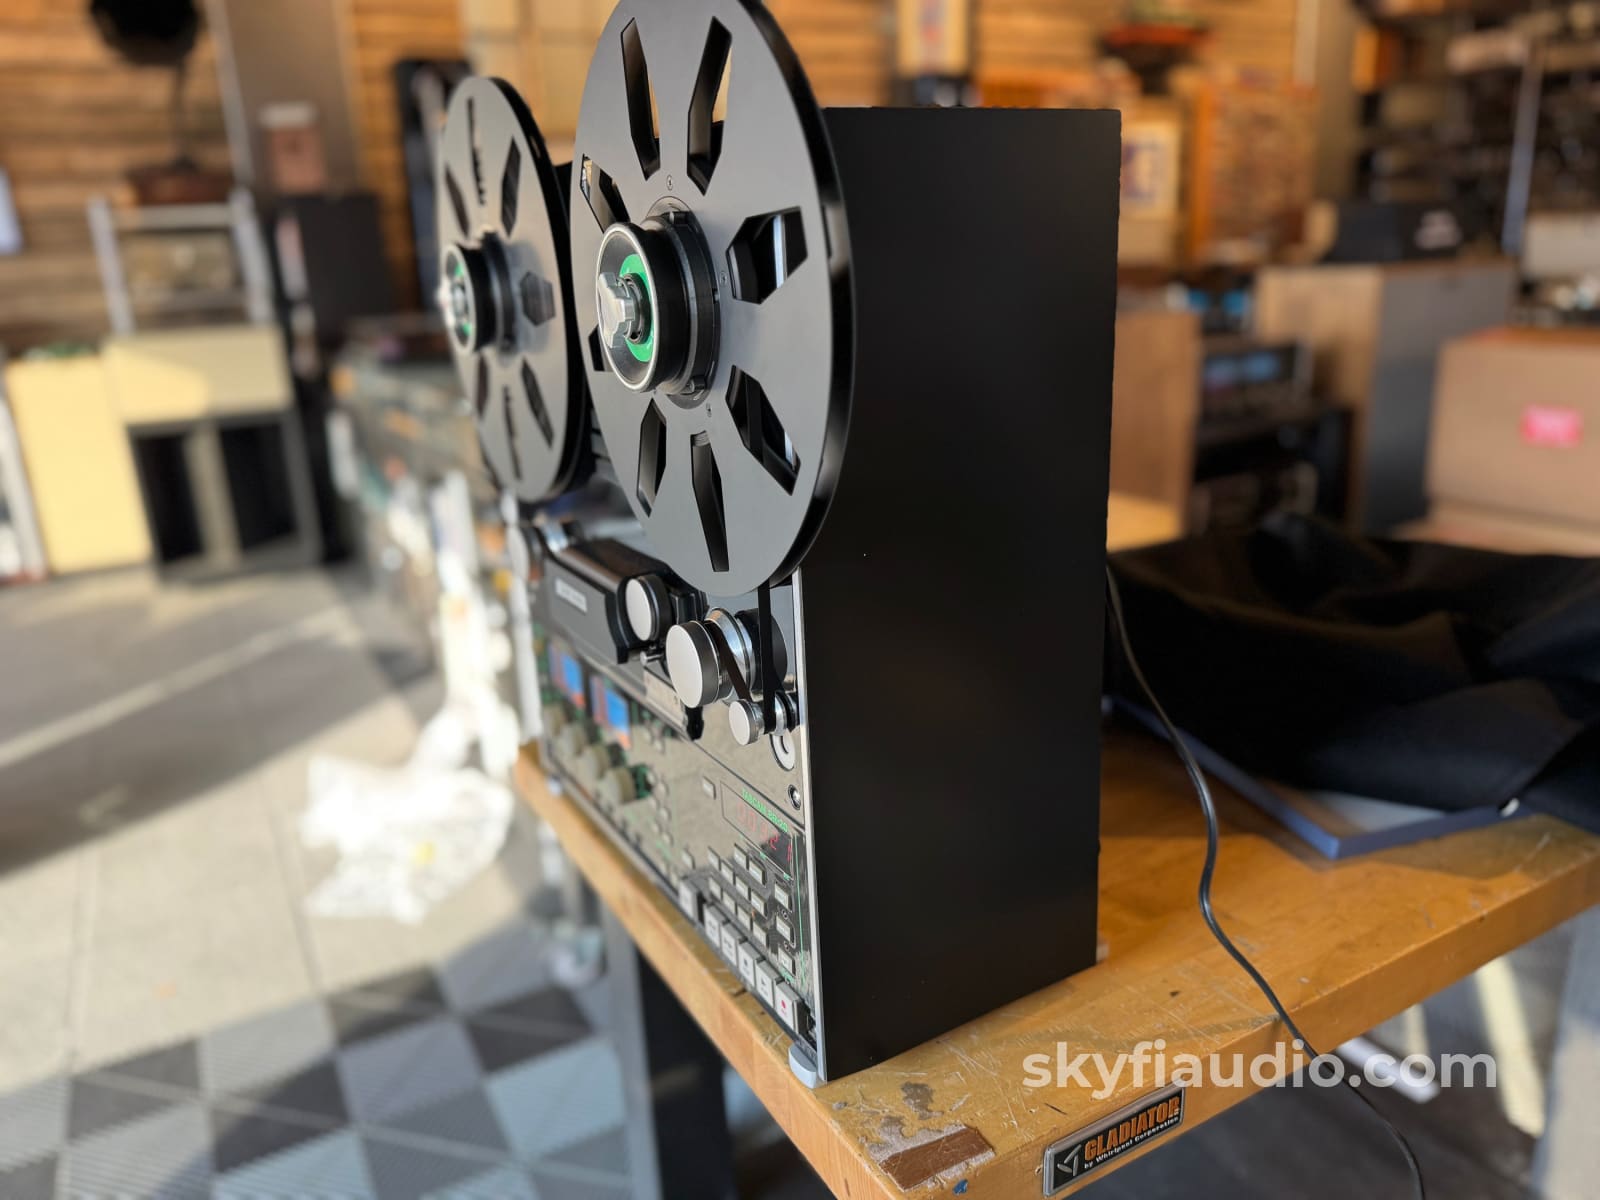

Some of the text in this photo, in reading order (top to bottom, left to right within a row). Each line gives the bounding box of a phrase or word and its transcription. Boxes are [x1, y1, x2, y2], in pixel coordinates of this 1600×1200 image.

[1084, 1096, 1181, 1161] GLADIATOR
[1096, 1139, 1133, 1163] Whirlpool
[1134, 1116, 1179, 1143] Corporation
